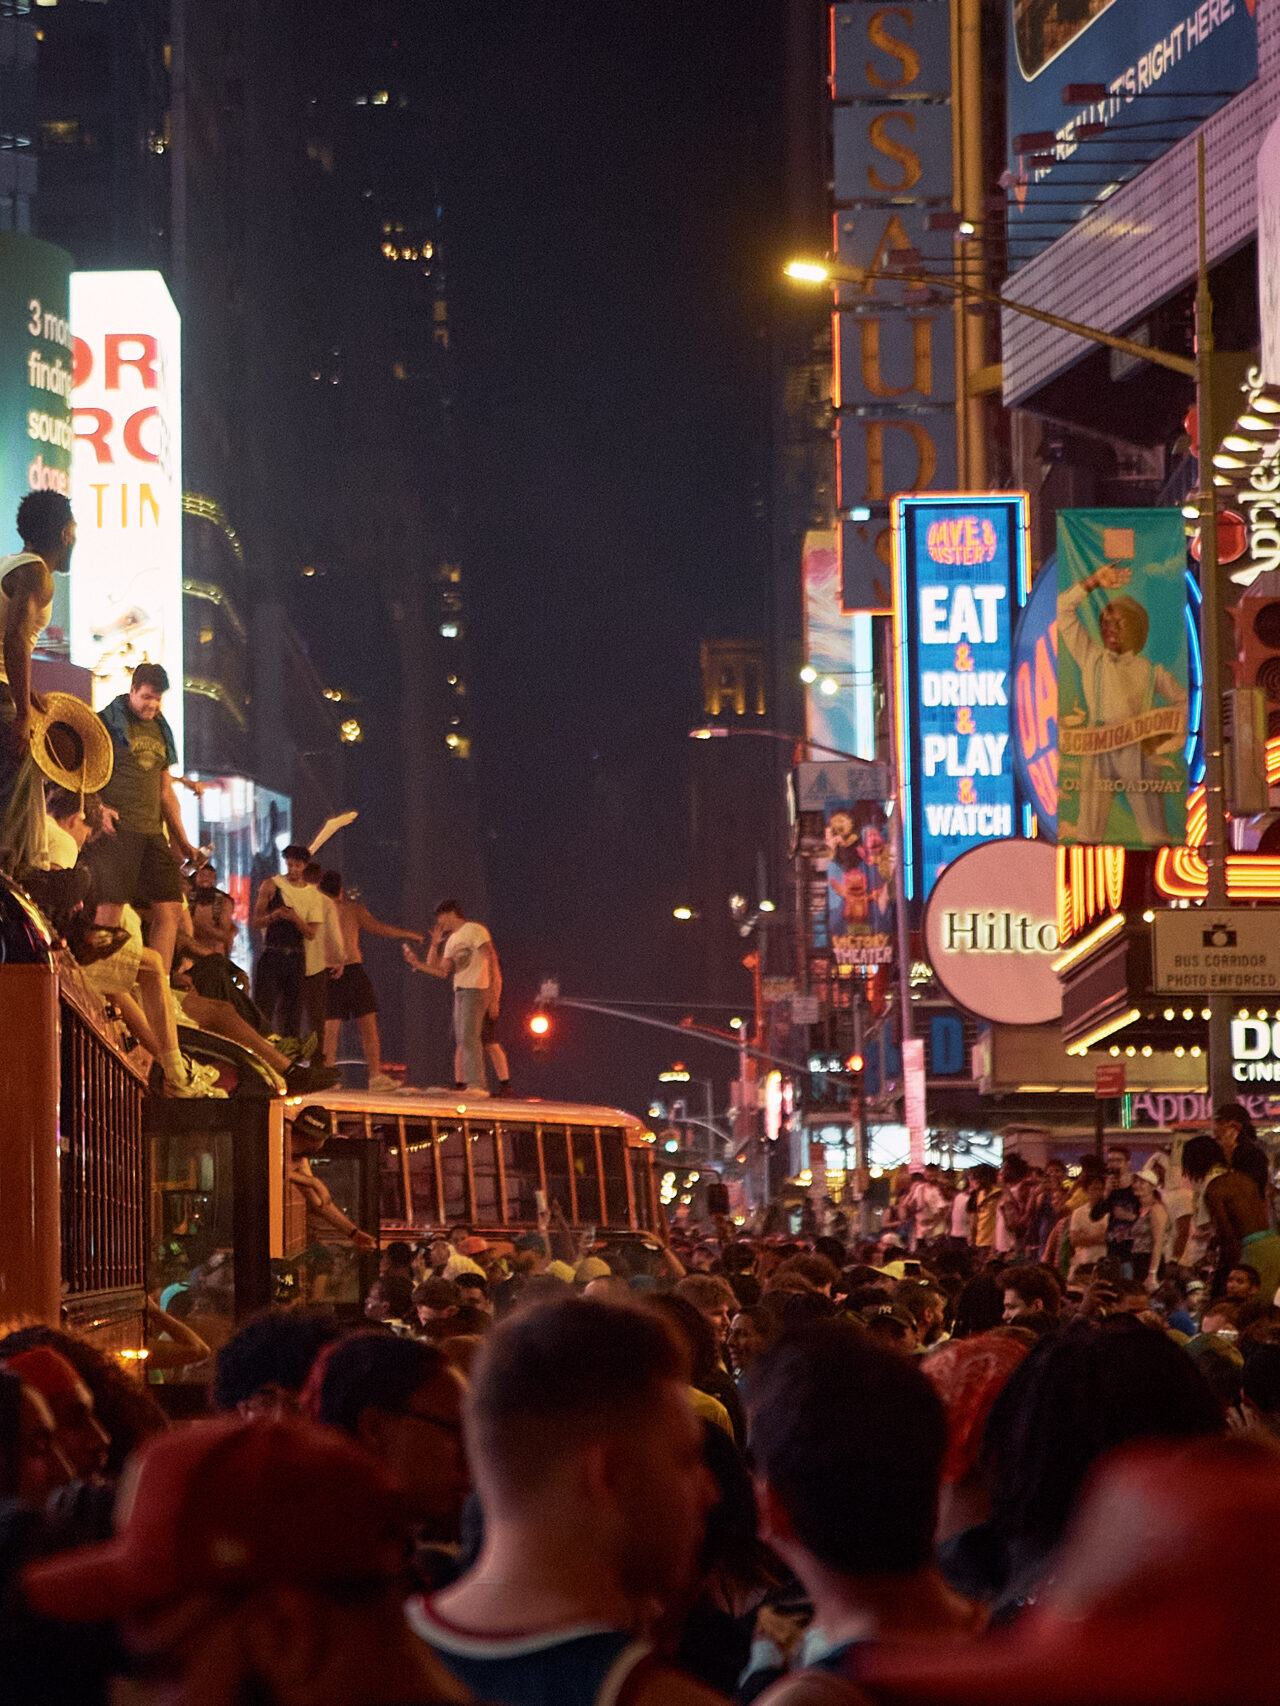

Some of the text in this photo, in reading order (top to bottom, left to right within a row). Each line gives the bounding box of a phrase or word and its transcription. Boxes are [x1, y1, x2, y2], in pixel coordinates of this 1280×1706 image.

[1110, 67, 1136, 118] IT'S
[1138, 23, 1185, 95] RIGHT
[28, 299, 42, 337] 3
[928, 517, 980, 546] DAVE
[920, 584, 1007, 645] EAT
[953, 642, 975, 672] &
[922, 671, 1008, 707] DRINK
[956, 706, 976, 735] &
[923, 734, 1009, 777] PLAY
[957, 776, 977, 805] &
[925, 803, 1012, 837] WATCH
[944, 911, 1062, 952] Hilto
[1174, 954, 1267, 968] BUS CORRIDOR
[1166, 974, 1276, 987] PHOTO ENFORCED
[1231, 1018, 1280, 1060] D
